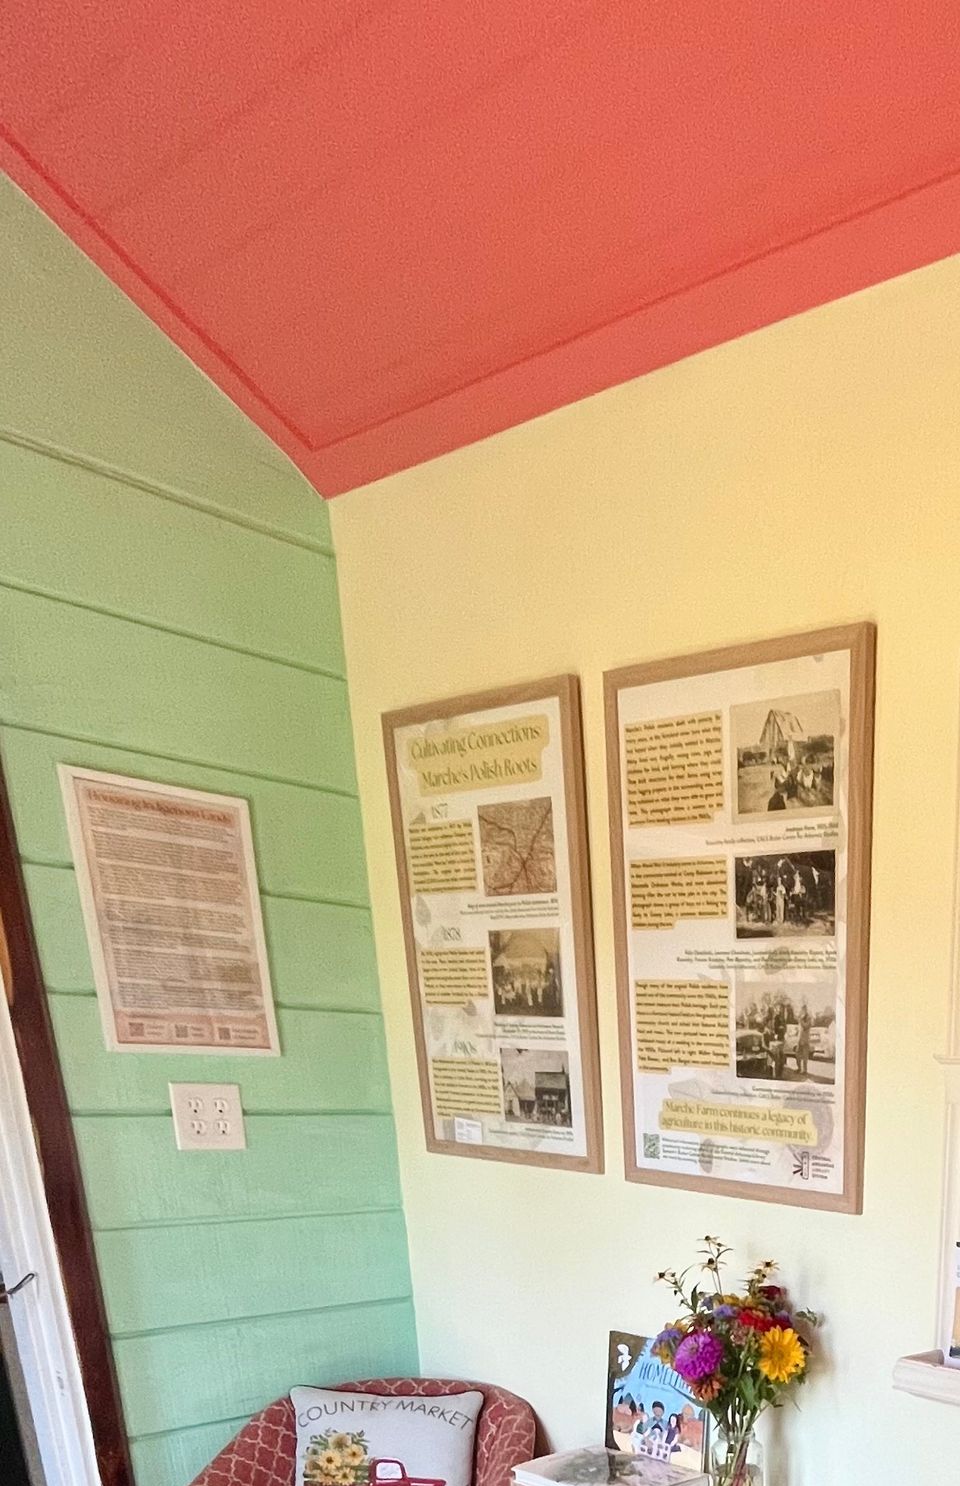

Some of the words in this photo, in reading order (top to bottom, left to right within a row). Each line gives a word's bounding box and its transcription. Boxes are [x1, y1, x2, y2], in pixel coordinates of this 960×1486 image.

[467, 725, 541, 750] Connections
[504, 758, 538, 777] Roots
[719, 1107, 760, 1119] continues
[297, 1400, 394, 1428] COUNTRY
[395, 1400, 474, 1430] MARKET
